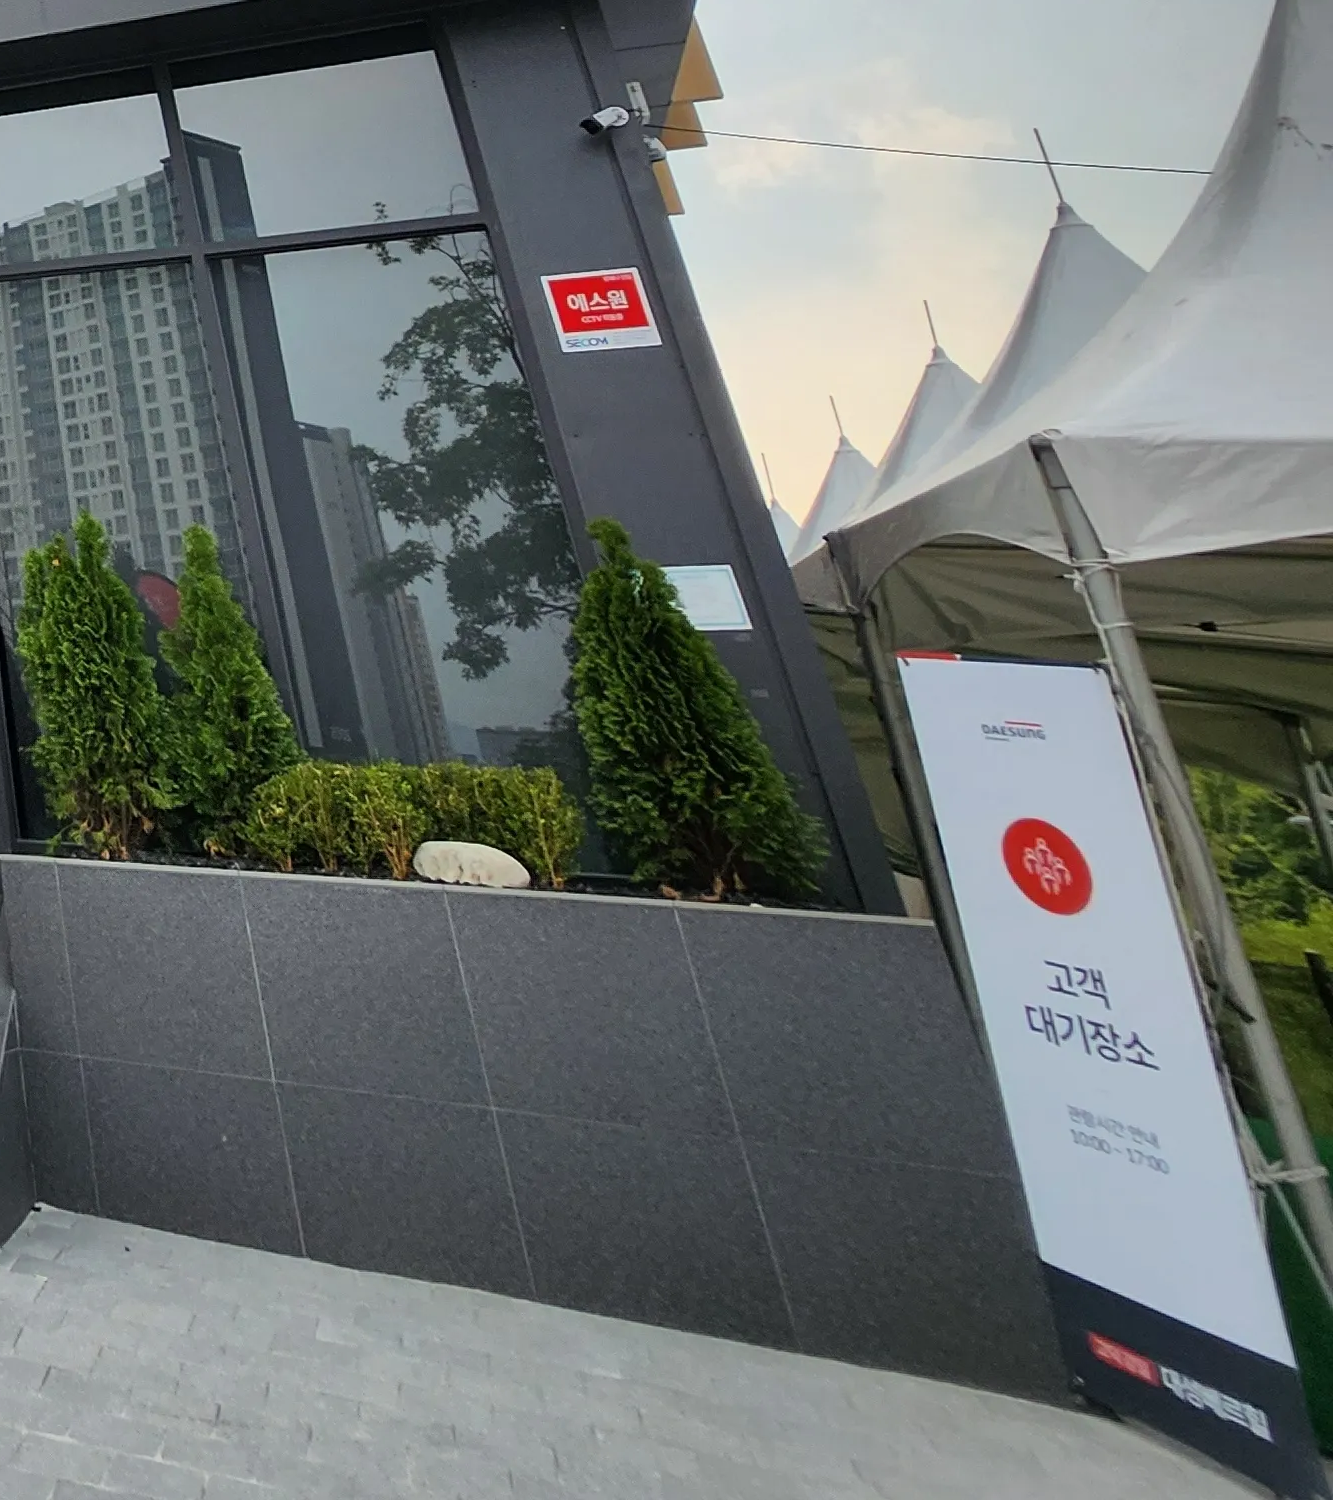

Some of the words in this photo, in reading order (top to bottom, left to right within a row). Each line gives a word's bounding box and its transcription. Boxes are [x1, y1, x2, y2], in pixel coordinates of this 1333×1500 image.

[567, 289, 629, 313] 에스원
[566, 336, 609, 348] SECOM
[981, 723, 1047, 740] DAESUNG
[1043, 959, 1113, 1011] 고객
[1024, 1004, 1161, 1071] 대기장소
[1126, 1147, 1170, 1175] 17:00
